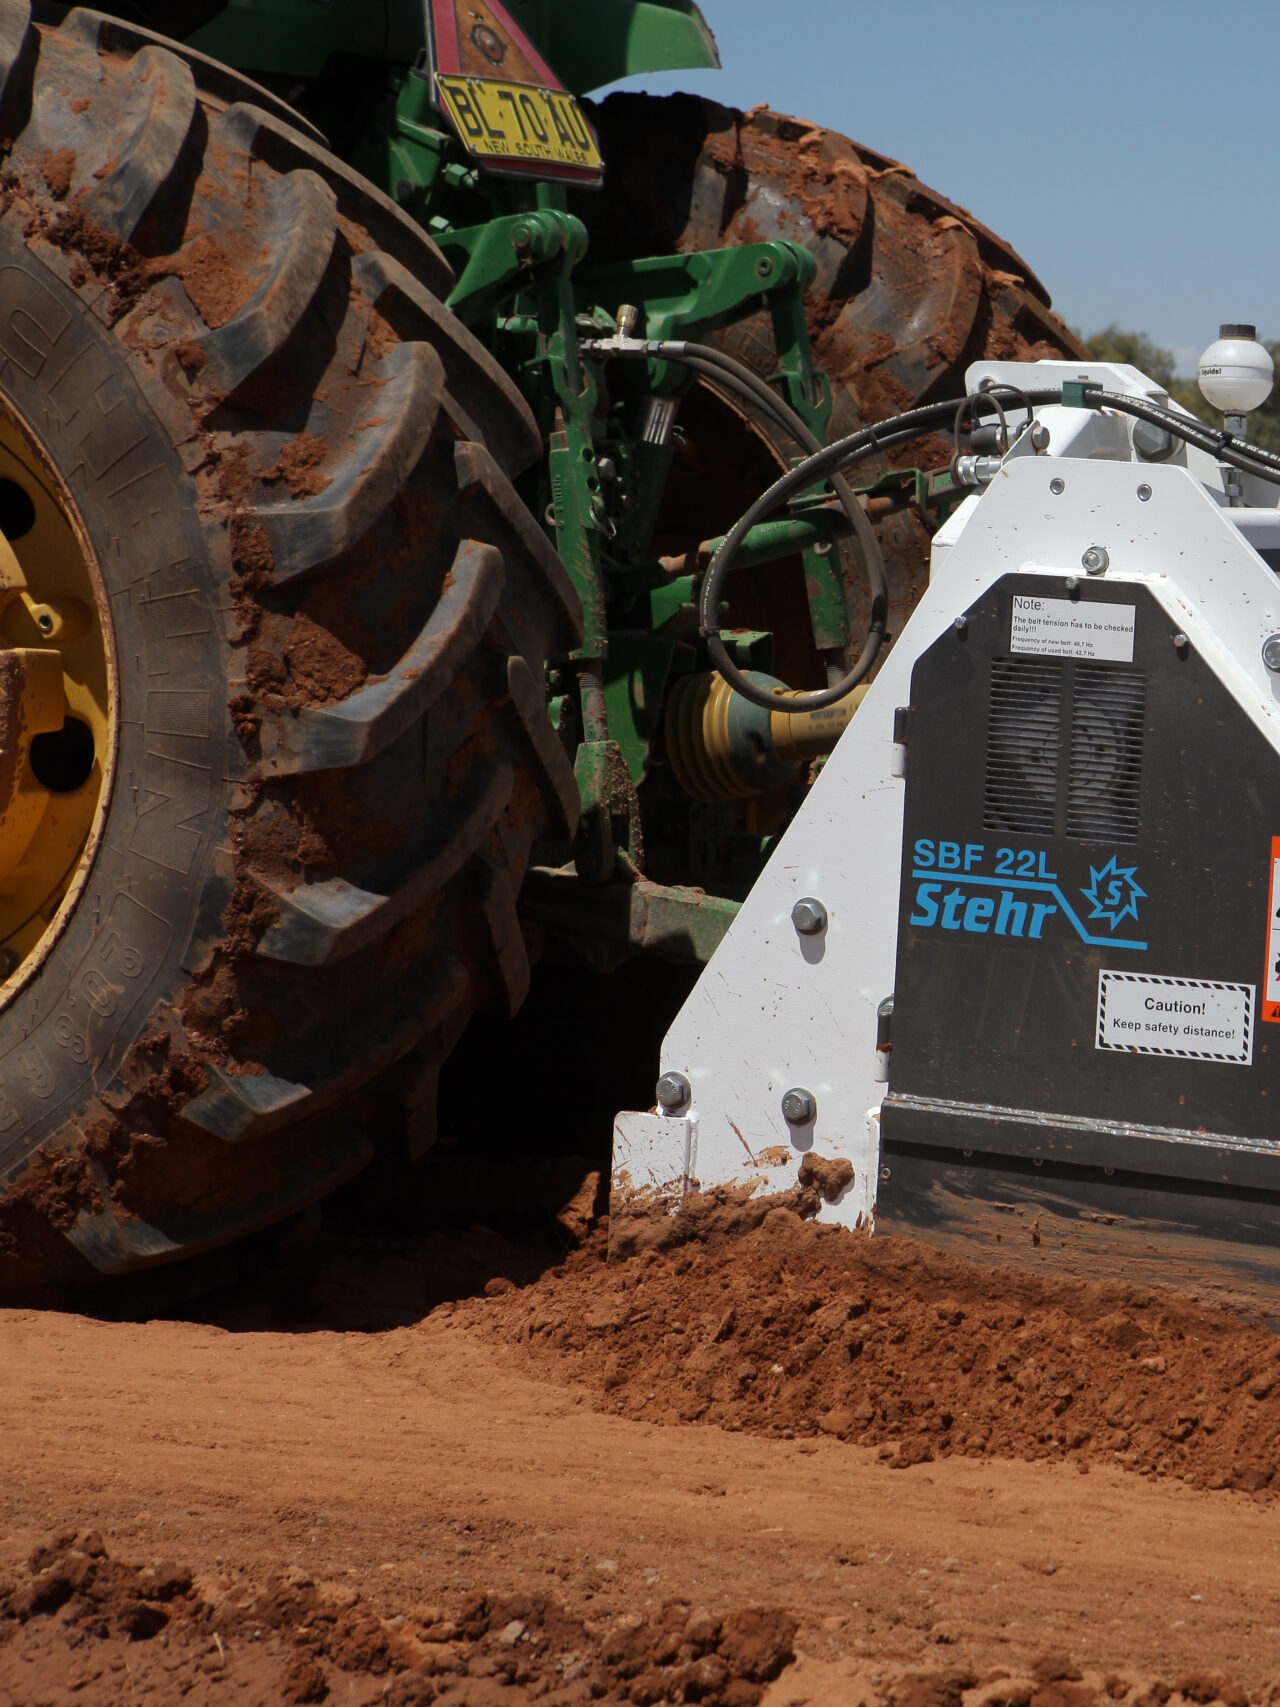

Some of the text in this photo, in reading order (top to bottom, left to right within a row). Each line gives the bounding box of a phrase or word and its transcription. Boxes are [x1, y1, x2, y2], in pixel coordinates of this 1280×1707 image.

[484, 140, 589, 165] NEW SOUTH WALES
[1014, 597, 1045, 611] Note:
[1013, 625, 1037, 634] daily!!!
[1014, 616, 1027, 624] The
[1028, 617, 1041, 625] belt
[1043, 618, 1069, 627] tension
[1070, 621, 1083, 629] has
[1093, 623, 1103, 631] be
[1104, 624, 1134, 633] checked
[1012, 636, 1040, 644] Frequency
[1060, 639, 1072, 647] belt:
[1012, 644, 1040, 653] Frequency
[913, 839, 1058, 880] SBF 22L
[910, 882, 1058, 939] Stehr
[1144, 997, 1207, 1015] Caution!
[1113, 1018, 1236, 1039] Keep safety distance!
